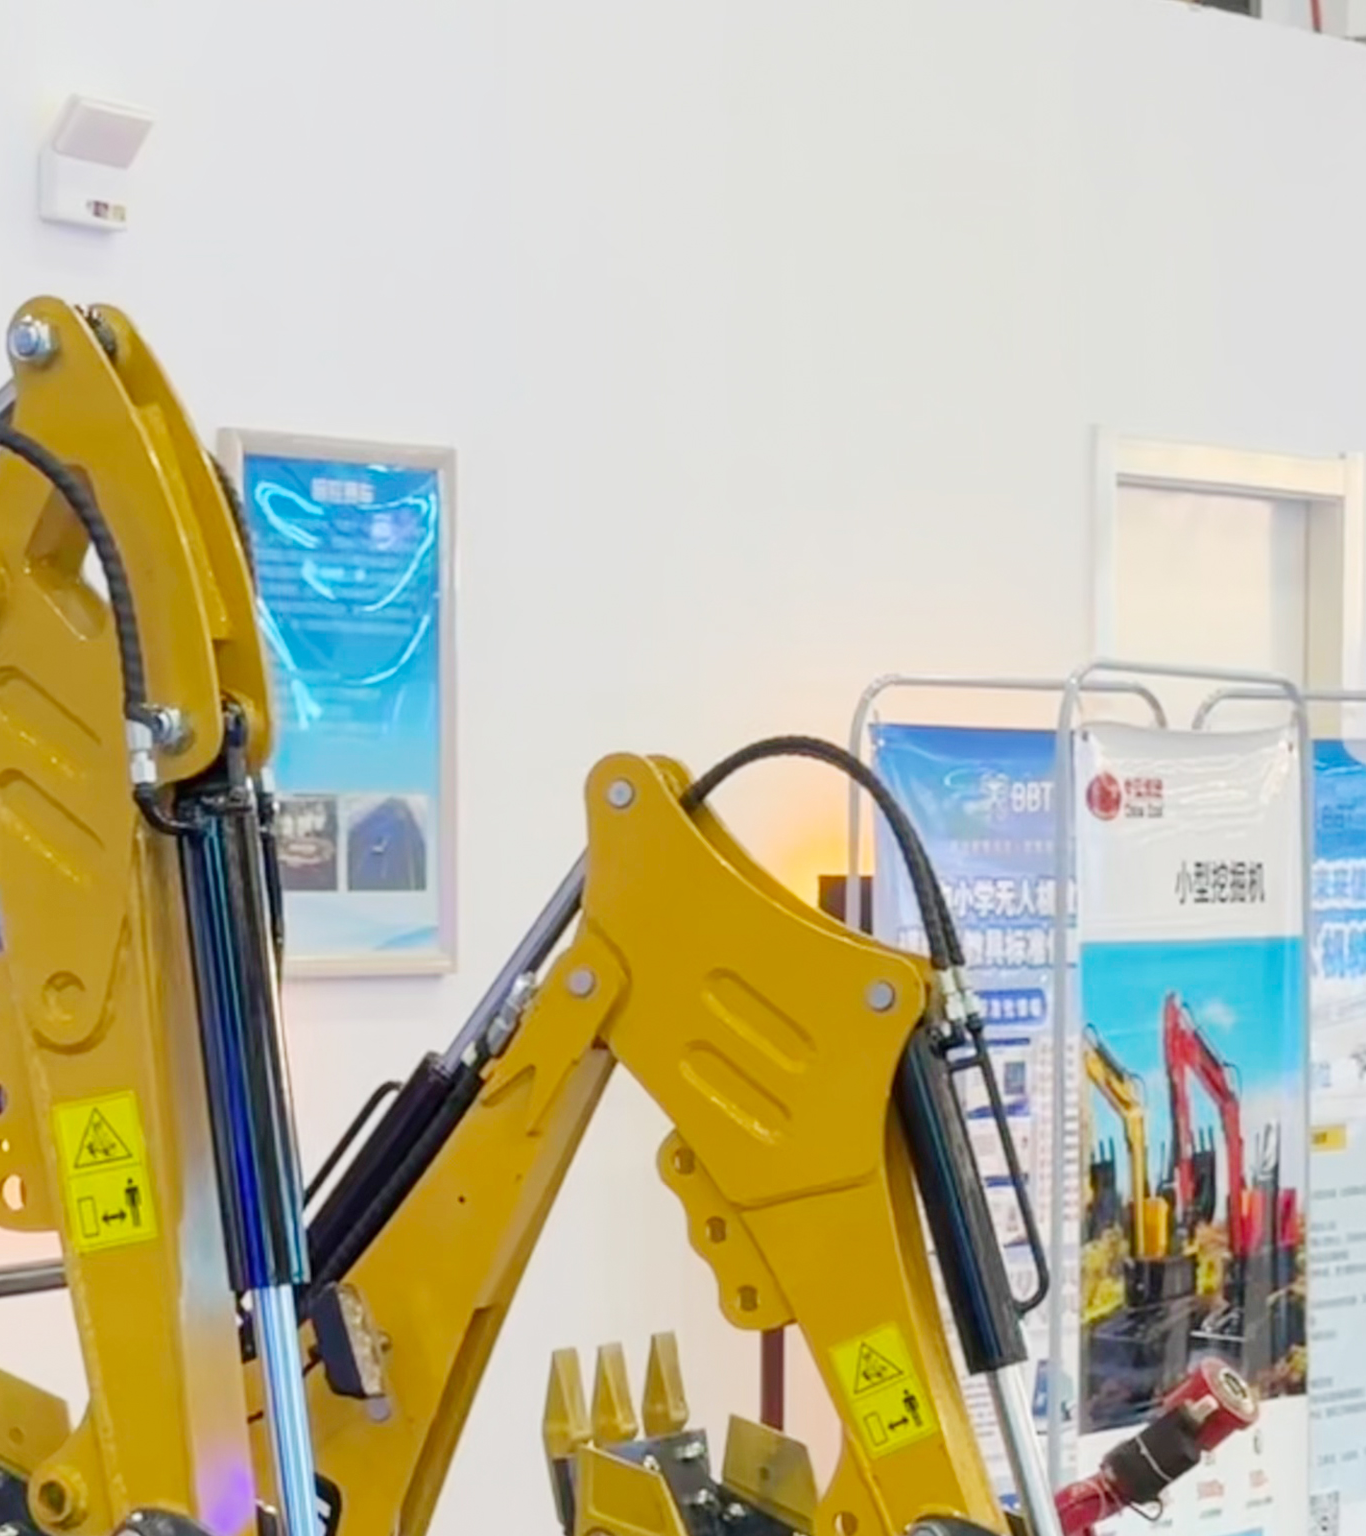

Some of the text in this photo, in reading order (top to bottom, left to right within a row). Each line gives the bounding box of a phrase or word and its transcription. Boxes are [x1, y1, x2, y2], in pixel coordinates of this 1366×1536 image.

[1174, 860, 1265, 905] 小型挖掘机
